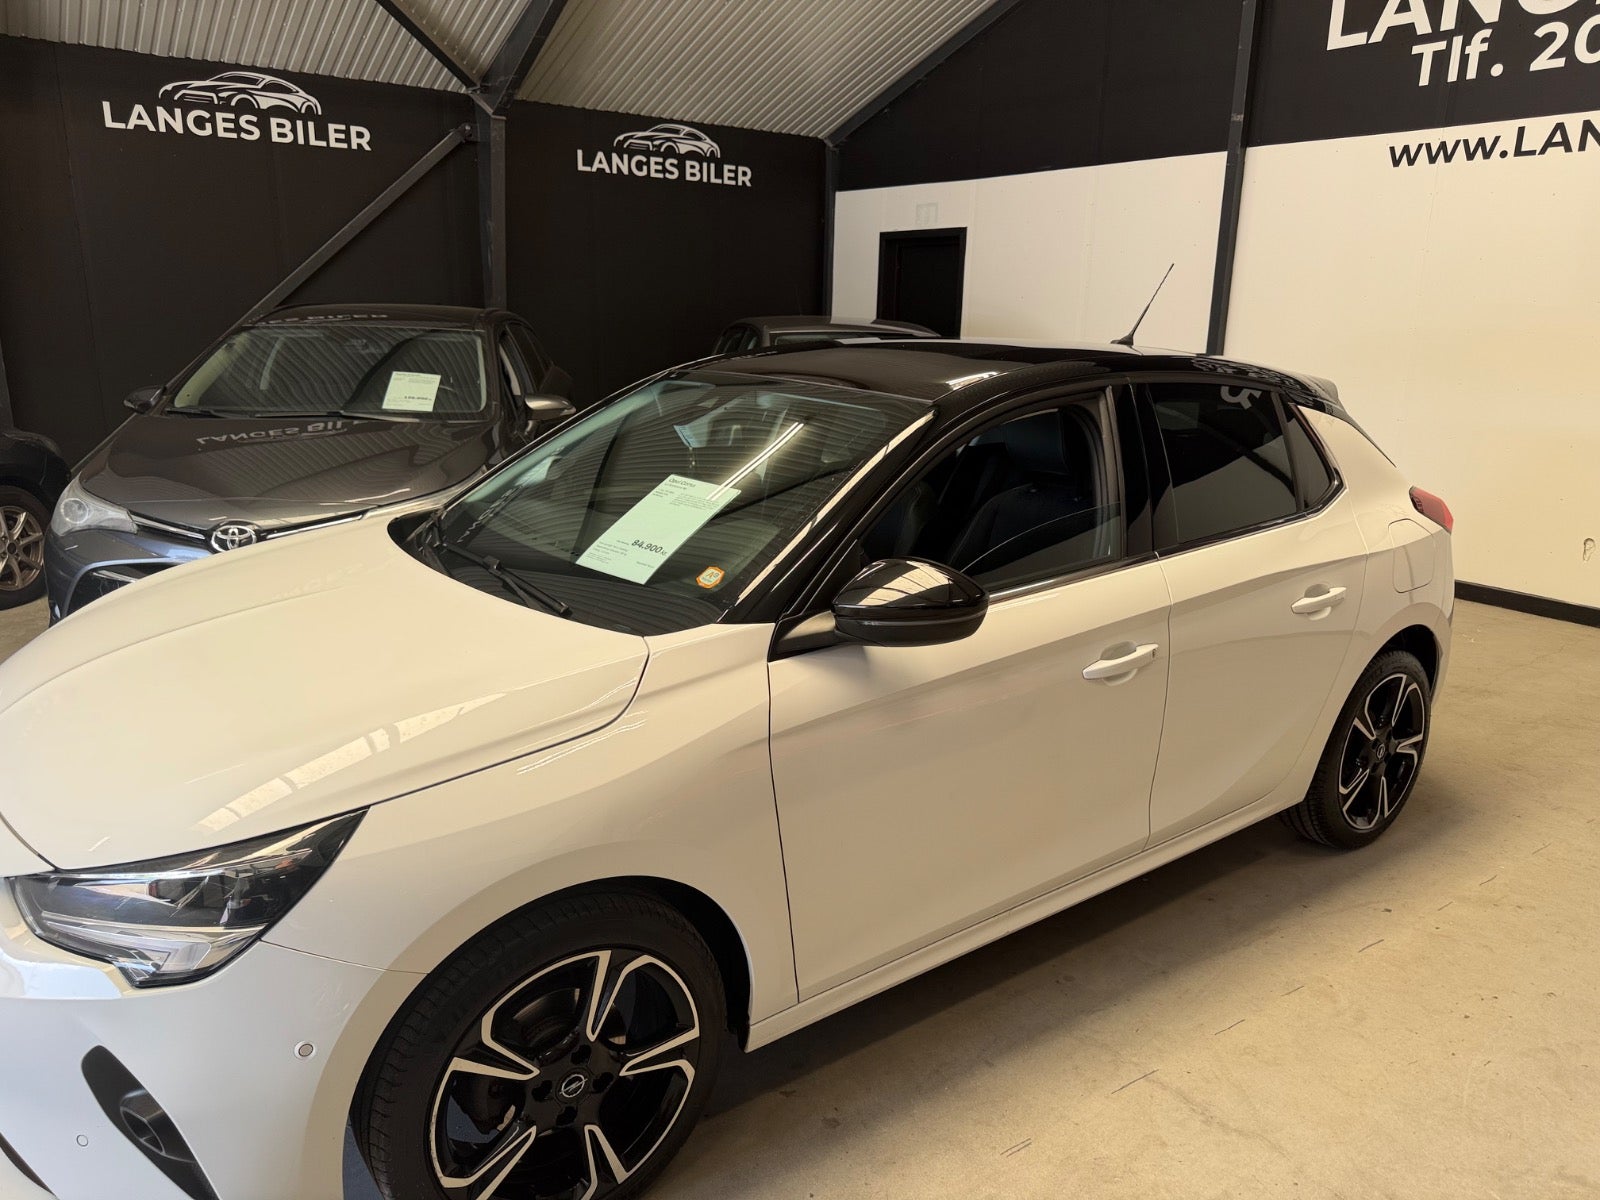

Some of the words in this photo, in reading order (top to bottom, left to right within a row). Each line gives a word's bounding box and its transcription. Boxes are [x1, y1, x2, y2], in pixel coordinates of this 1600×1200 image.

[1327, 0, 1600, 50] LAN
[1411, 29, 1504, 87] Tlf.
[1529, 14, 1600, 72] 20
[101, 100, 261, 141] LANGES
[269, 117, 372, 151] BILER
[1389, 119, 1600, 168] www.LAN
[576, 149, 679, 180] LANGES
[685, 160, 752, 188] BILER
[631, 539, 663, 554] 84.900
